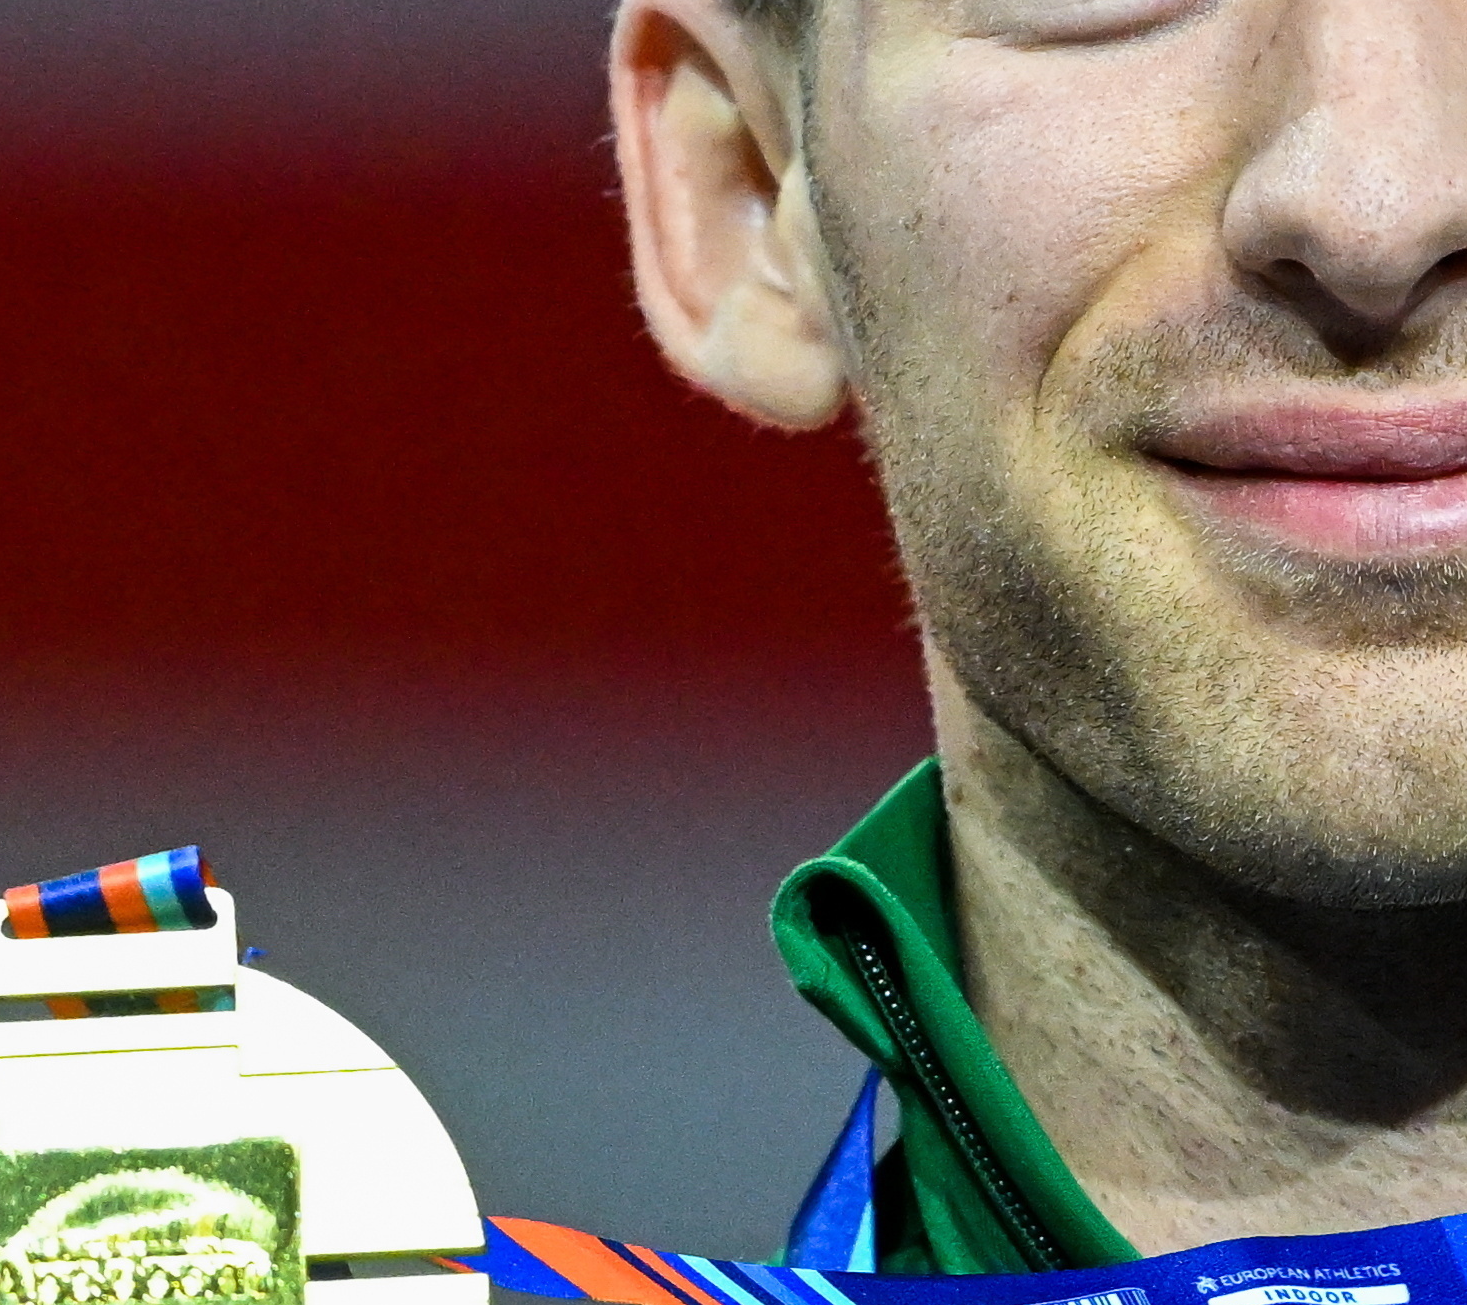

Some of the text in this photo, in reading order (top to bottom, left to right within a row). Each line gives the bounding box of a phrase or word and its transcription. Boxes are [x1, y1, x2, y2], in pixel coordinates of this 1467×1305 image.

[1219, 1263, 1401, 1286] EUROPEAN ATHLETICS
[1264, 1290, 1357, 1304] INDOOR
